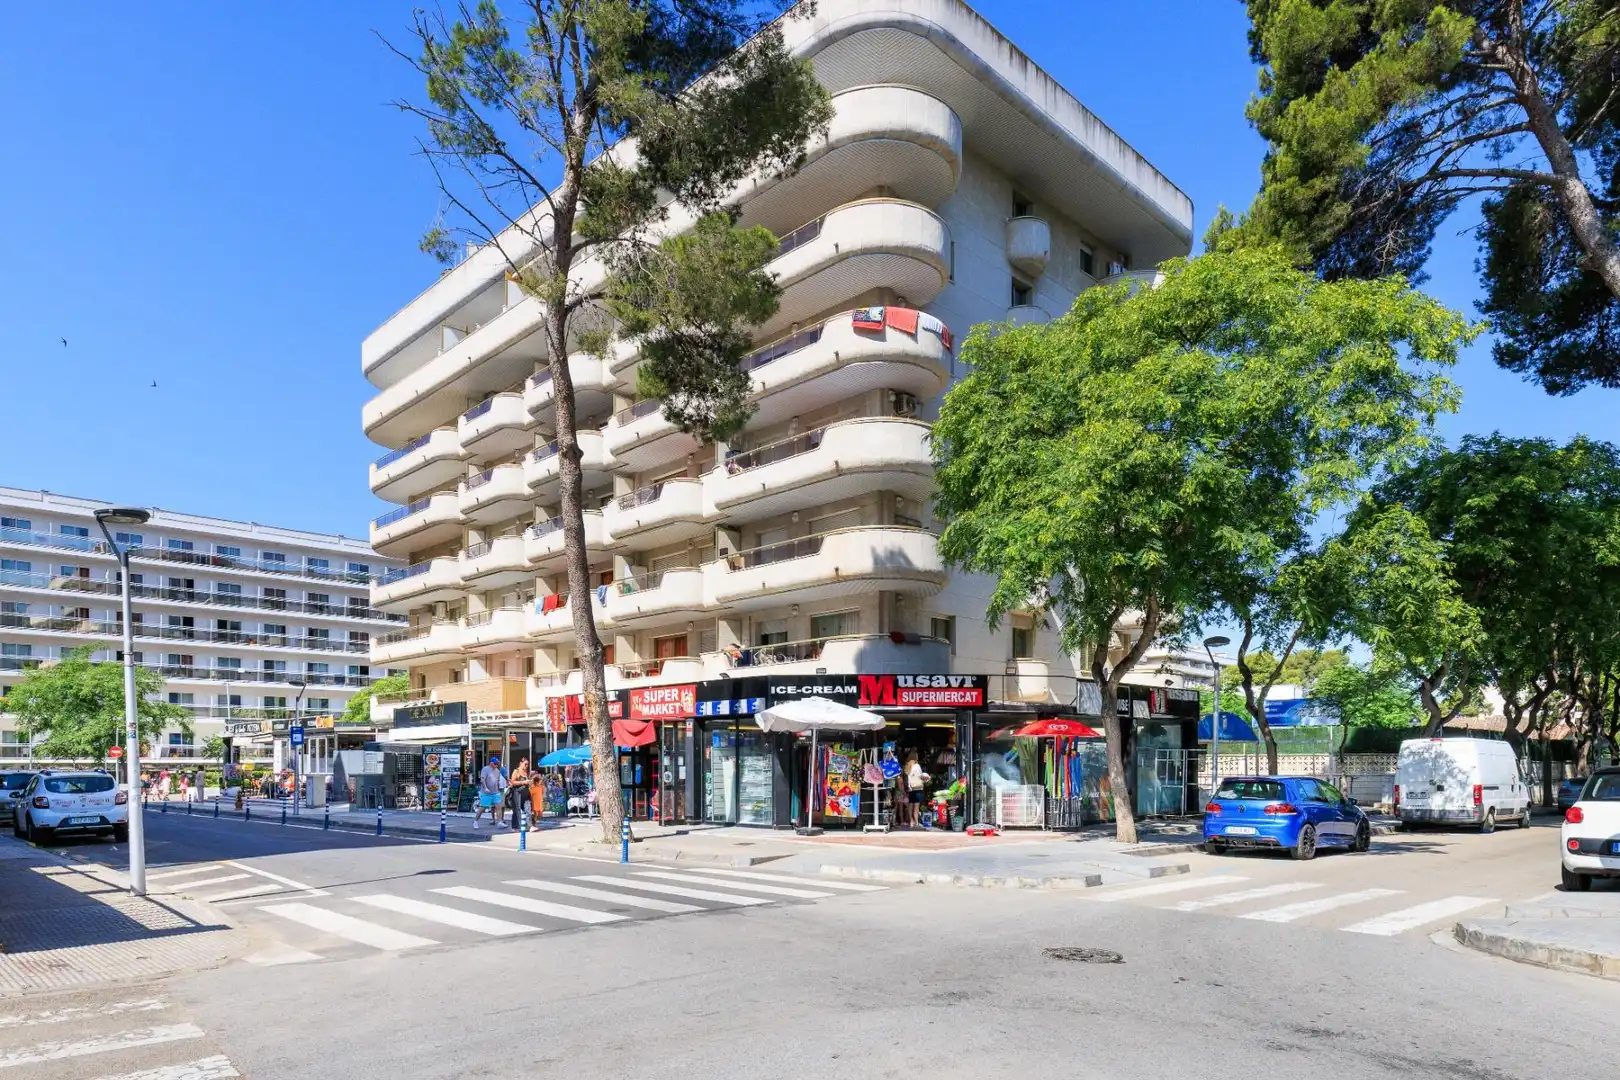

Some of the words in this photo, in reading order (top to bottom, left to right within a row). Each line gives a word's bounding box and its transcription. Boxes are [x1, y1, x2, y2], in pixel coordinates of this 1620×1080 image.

[643, 688, 679, 703] SUPER
[771, 685, 857, 694] ICE-CREAM
[902, 691, 978, 702] SUPERMERCAT
[641, 702, 682, 716] MARKET
